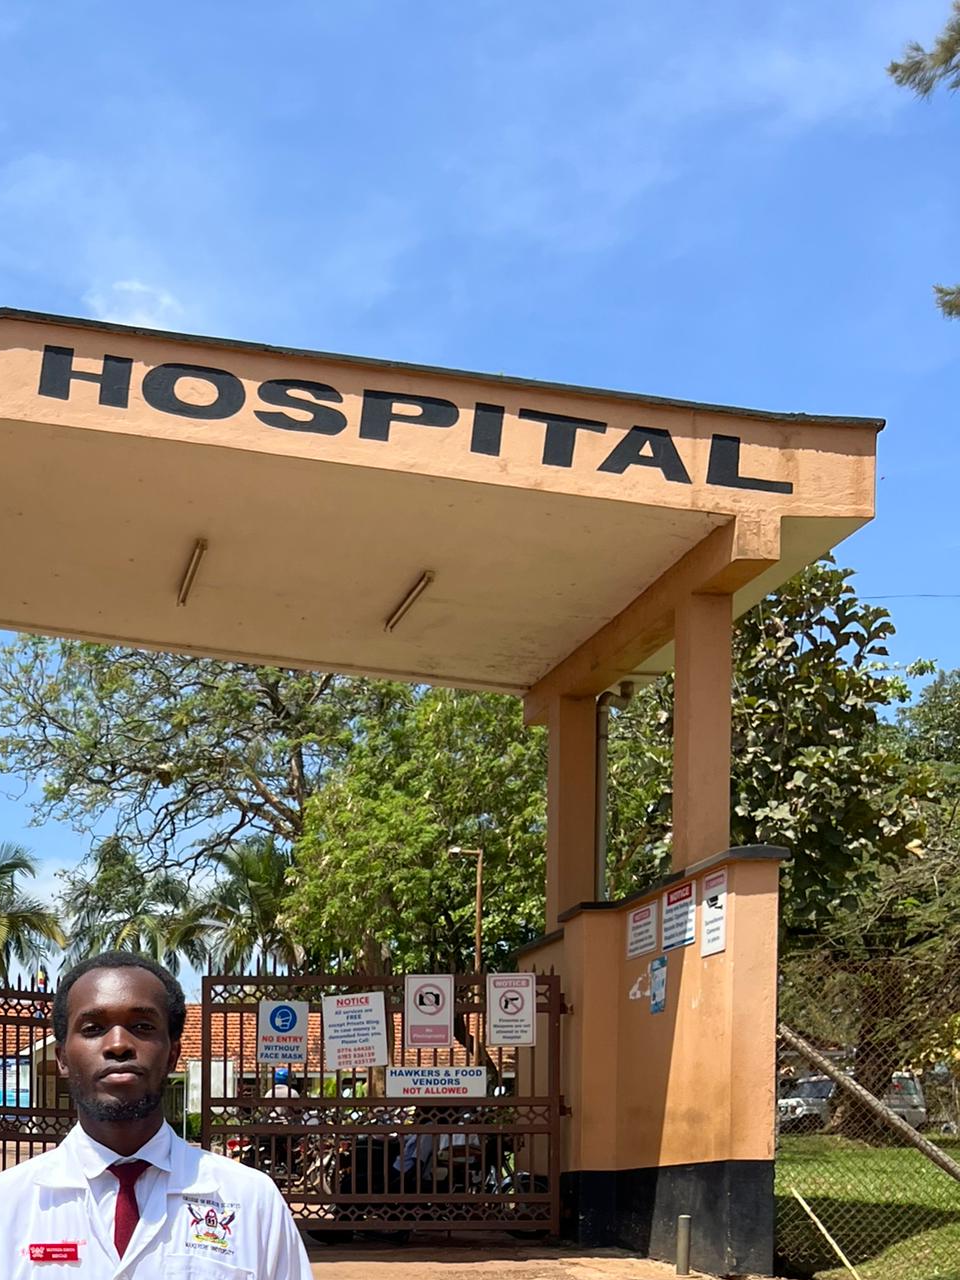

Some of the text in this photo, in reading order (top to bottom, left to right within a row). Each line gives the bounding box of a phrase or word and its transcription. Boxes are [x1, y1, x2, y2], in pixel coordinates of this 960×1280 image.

[38, 344, 794, 495] HOSPITAL
[336, 996, 369, 1006] NOTICE
[262, 1035, 303, 1043] NO ENTRY
[390, 1069, 482, 1077] HAWKERS & FOOD
[412, 1078, 460, 1086] VENDORS
